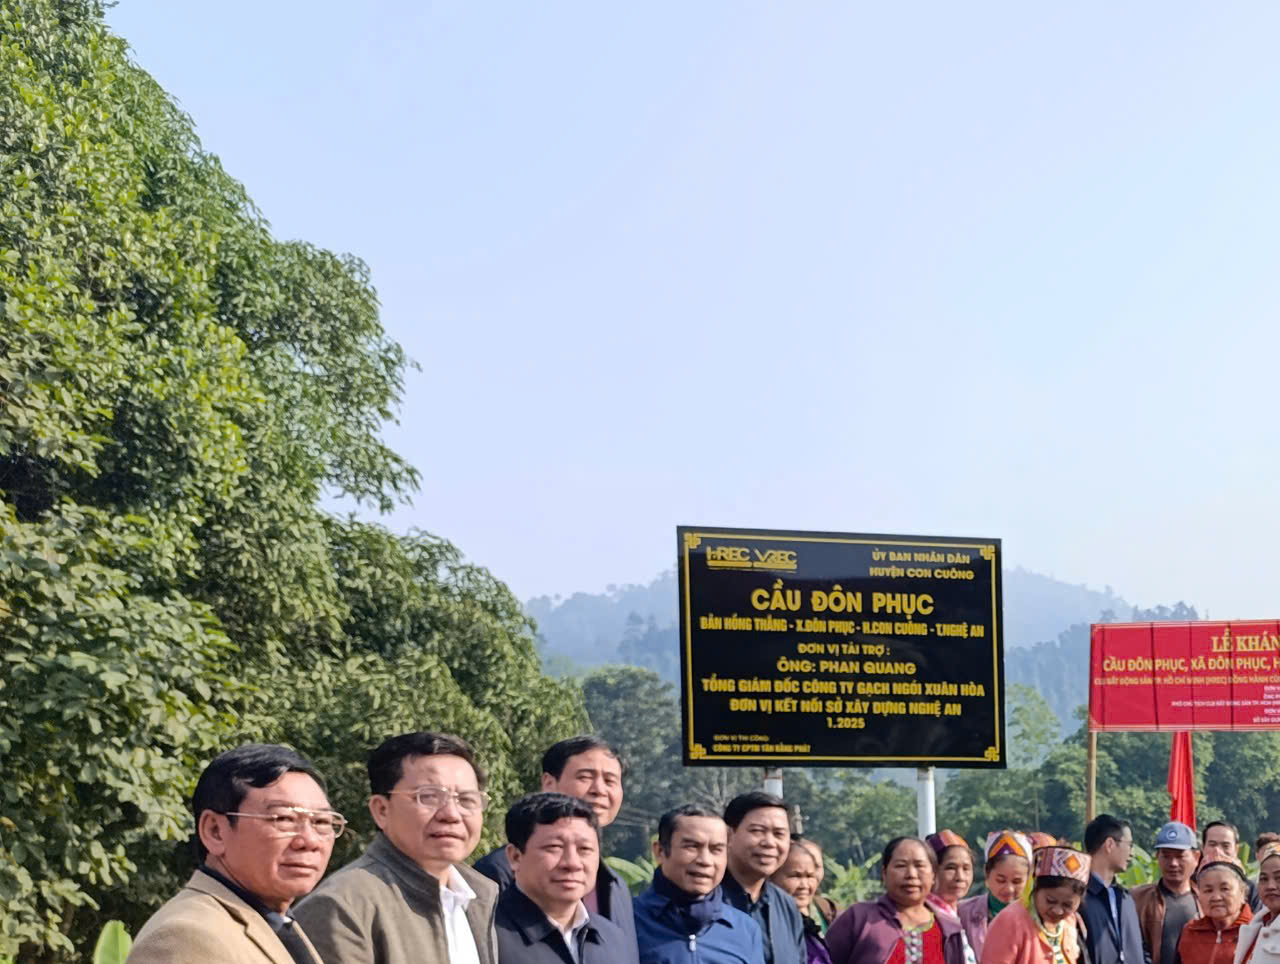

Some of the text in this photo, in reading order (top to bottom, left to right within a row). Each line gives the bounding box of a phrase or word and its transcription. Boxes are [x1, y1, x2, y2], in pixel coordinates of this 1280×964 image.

[889, 552, 911, 561] BAN
[914, 551, 944, 562] NHÂN
[947, 552, 970, 564] DÂN
[869, 565, 974, 580] HUYỆN CON CUÔNG
[751, 579, 934, 620] CẦU ĐÔN PHỤC
[828, 620, 855, 635] PHỤC
[970, 624, 984, 637] AN
[1211, 626, 1232, 652] LỄ
[797, 643, 824, 654] ĐƠN
[827, 644, 839, 656] VỊ
[776, 656, 916, 674] ÔNG: PHAN QUANG
[1103, 656, 1126, 671] CẦU
[1127, 656, 1153, 671] ĐÔN
[1155, 658, 1188, 672] PHỤC,
[1191, 655, 1206, 671] XÃ
[1208, 656, 1233, 670] ĐÔN
[1236, 657, 1271, 672] PHỤC,
[702, 672, 735, 692] TỔNG
[738, 677, 771, 692] GIÁM
[774, 676, 800, 693] ĐỐC
[802, 678, 837, 694] CÔNG
[839, 681, 854, 694] TY
[857, 682, 889, 697] GẠCH
[925, 681, 958, 696] XUÂN
[960, 681, 985, 696] HÒA
[730, 698, 757, 711] ĐƠN
[759, 698, 772, 714] VỊ
[774, 697, 798, 712] KẾT
[825, 696, 843, 713] SỞ
[845, 699, 869, 713] XÂY
[872, 701, 906, 717] DỰNG
[908, 700, 941, 718] NGHỆ
[944, 703, 962, 715] AN
[827, 717, 865, 729] 1.2025
